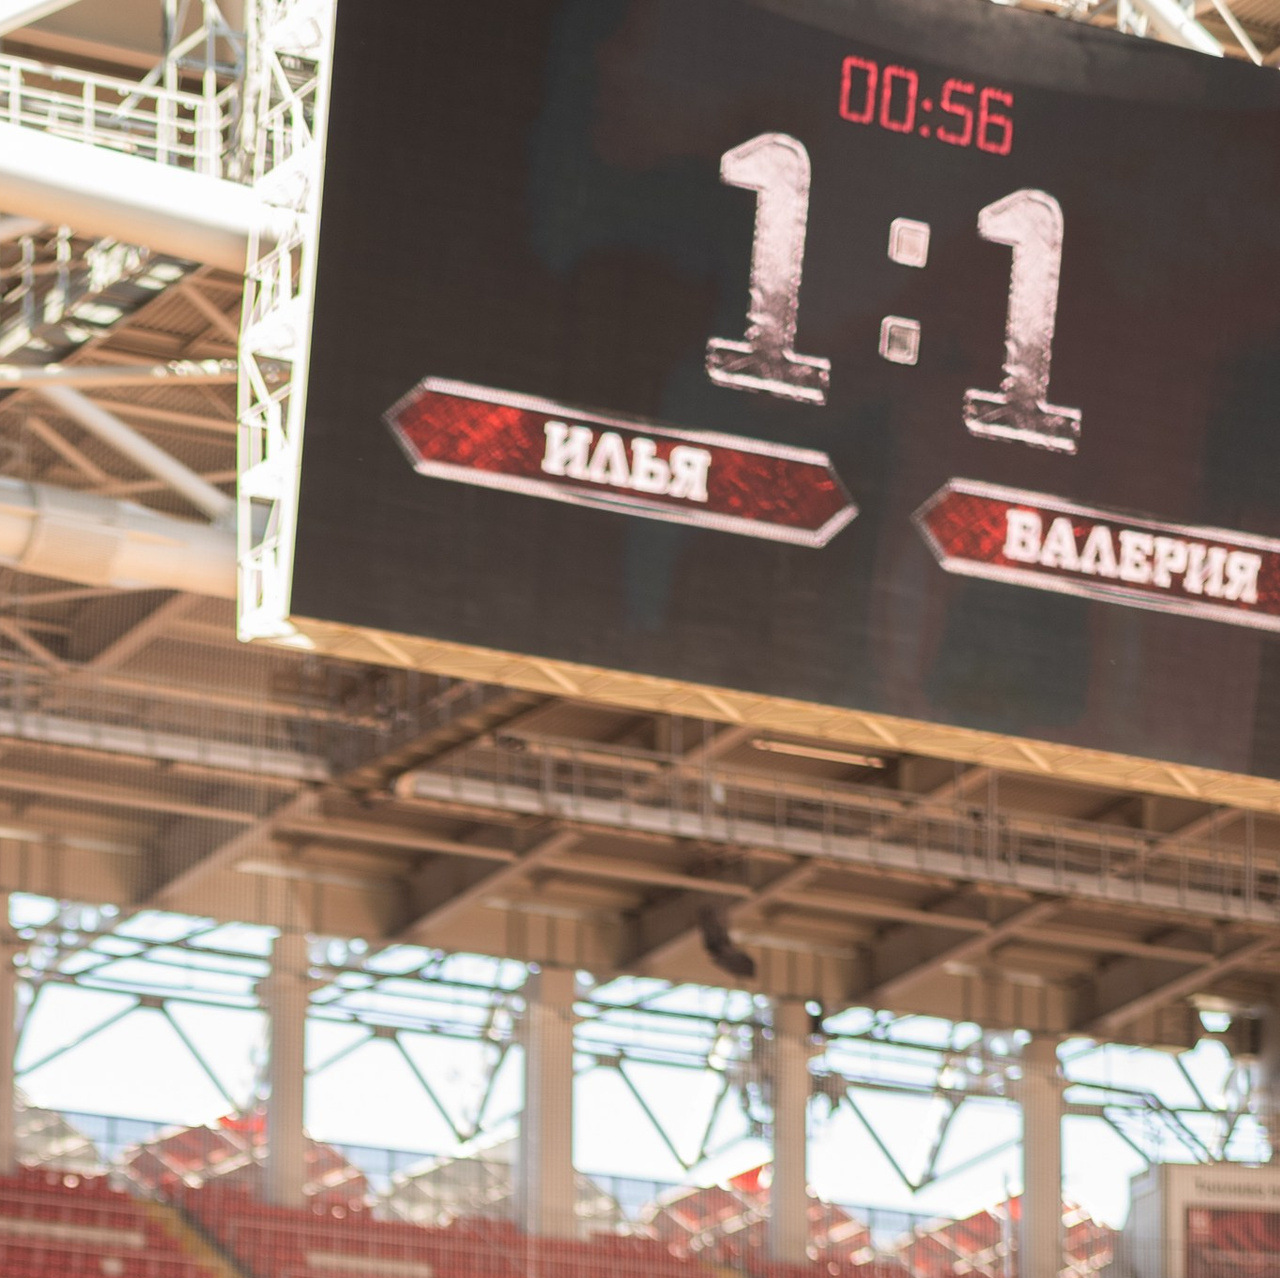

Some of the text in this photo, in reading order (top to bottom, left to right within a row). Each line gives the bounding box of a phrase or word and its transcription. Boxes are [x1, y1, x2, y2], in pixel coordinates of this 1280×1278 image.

[838, 54, 1014, 157] 00:56
[540, 419, 713, 503] ИЛЬЯ
[1002, 507, 1262, 605] ВАЛЕРИЯ
